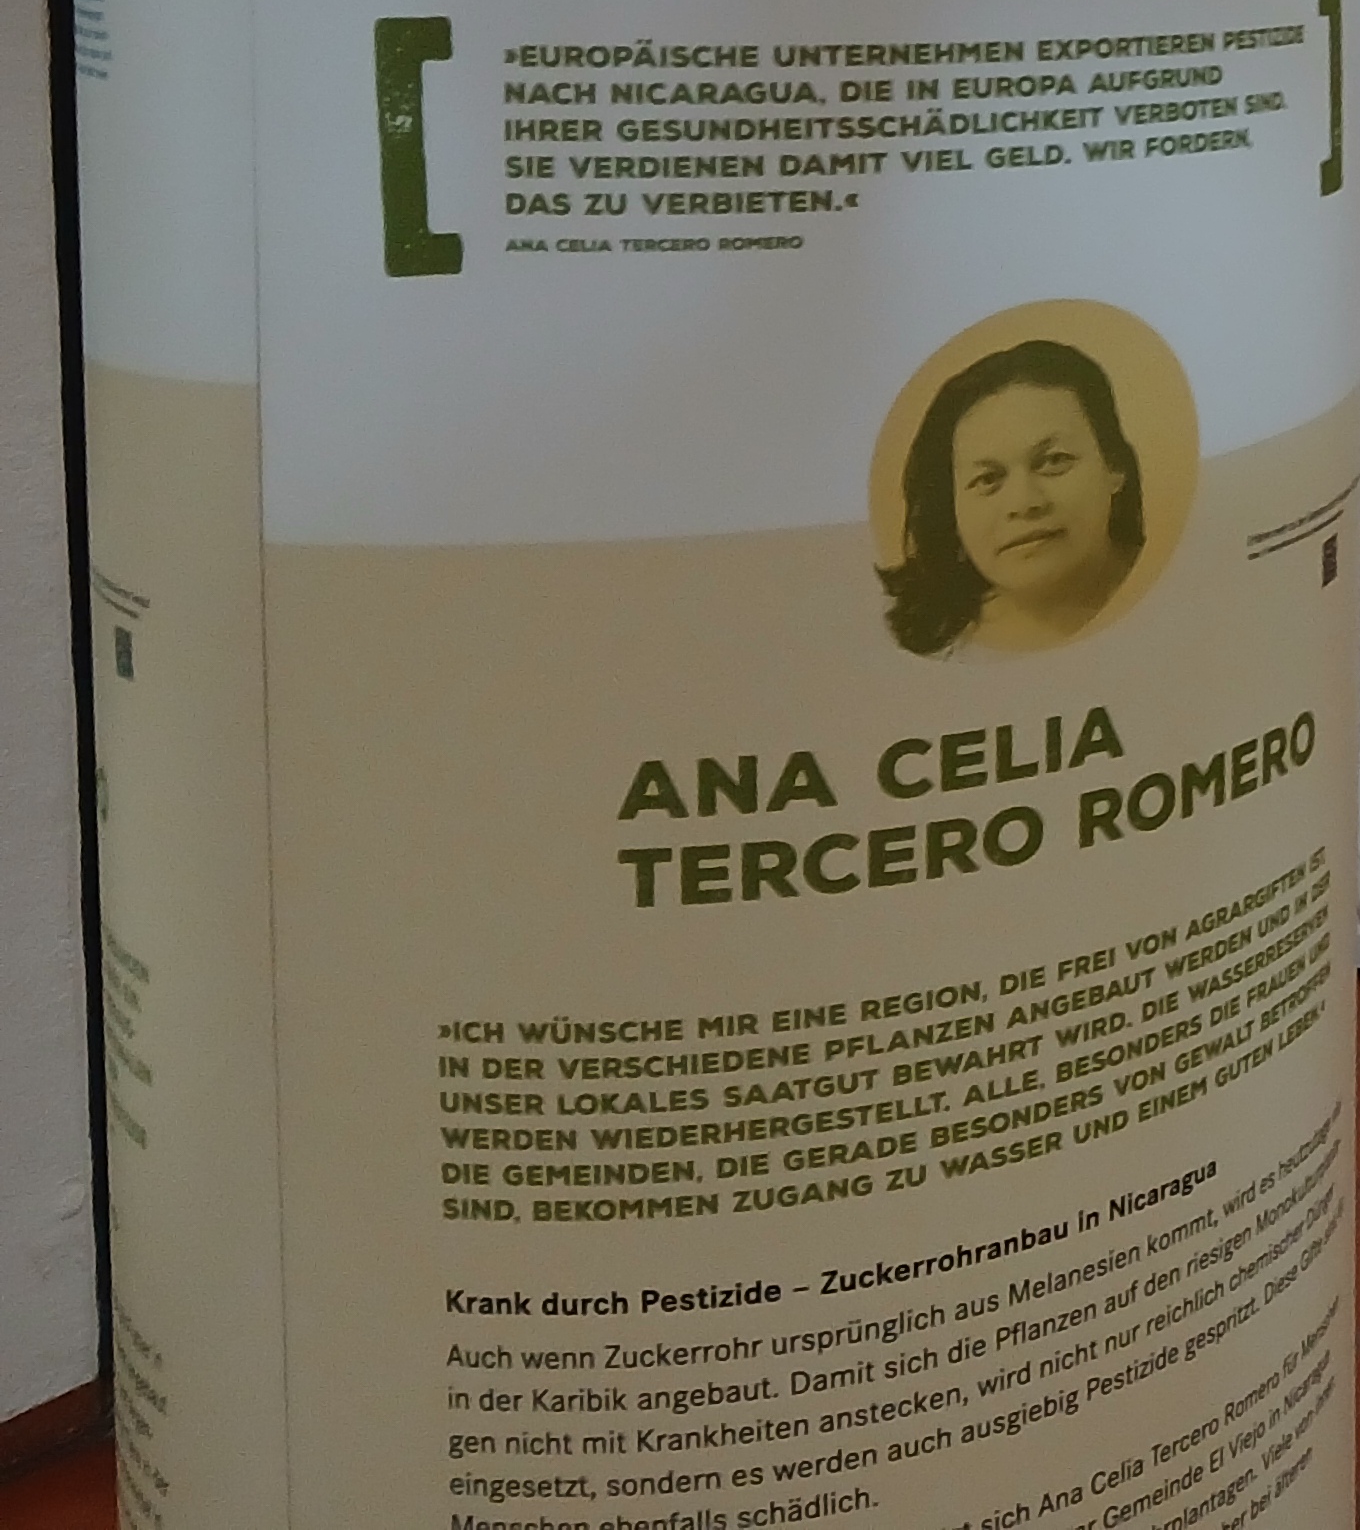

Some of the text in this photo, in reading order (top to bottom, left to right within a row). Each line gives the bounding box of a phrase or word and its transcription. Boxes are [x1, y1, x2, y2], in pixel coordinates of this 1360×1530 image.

[504, 66, 1223, 105] NACH NICARAGUA, DIE IN EUROPA AUFGRUND
[773, 42, 1025, 67] UNTERNEHMEN
[1037, 33, 1215, 61] EXPORTIEREN
[505, 119, 603, 141] IHRER
[616, 107, 1104, 142] GESUNDHEITSSCHÄDLICHKEIT
[1114, 97, 1238, 125] VERBOTEN
[505, 156, 555, 178] SIE
[569, 156, 765, 178] VERDIENEN
[778, 153, 888, 176] DAMIT
[901, 150, 974, 171] VIEL
[985, 145, 1072, 168] GELD.
[1083, 139, 1135, 161] WIR
[506, 193, 571, 216] DAS
[584, 193, 627, 216] ZU
[617, 706, 1125, 821] ANA CELIA
[617, 709, 1317, 910] TERCERO ROMERO
[519, 1020, 682, 1044] WÜNSCHE
[699, 1013, 757, 1039] MIR
[773, 1003, 845, 1032] EINE
[861, 978, 988, 1022] REGION,
[1000, 966, 1045, 995] DIE
[1058, 948, 1115, 982] FREI
[1126, 928, 1176, 959] VON
[446, 1289, 532, 1315] Krank
[541, 1291, 629, 1316] durch
[641, 1281, 781, 1313] Pestizide
[1078, 1210, 1100, 1232] in
[1109, 1161, 1217, 1221] Nicaragua
[447, 1344, 512, 1368] Auch
[521, 1352, 594, 1369] wenn
[605, 1337, 762, 1368] Zuckerrohr
[772, 1305, 945, 1355] ursprünglich
[955, 1294, 999, 1320] aus
[1009, 1246, 1140, 1306] Melanesien
